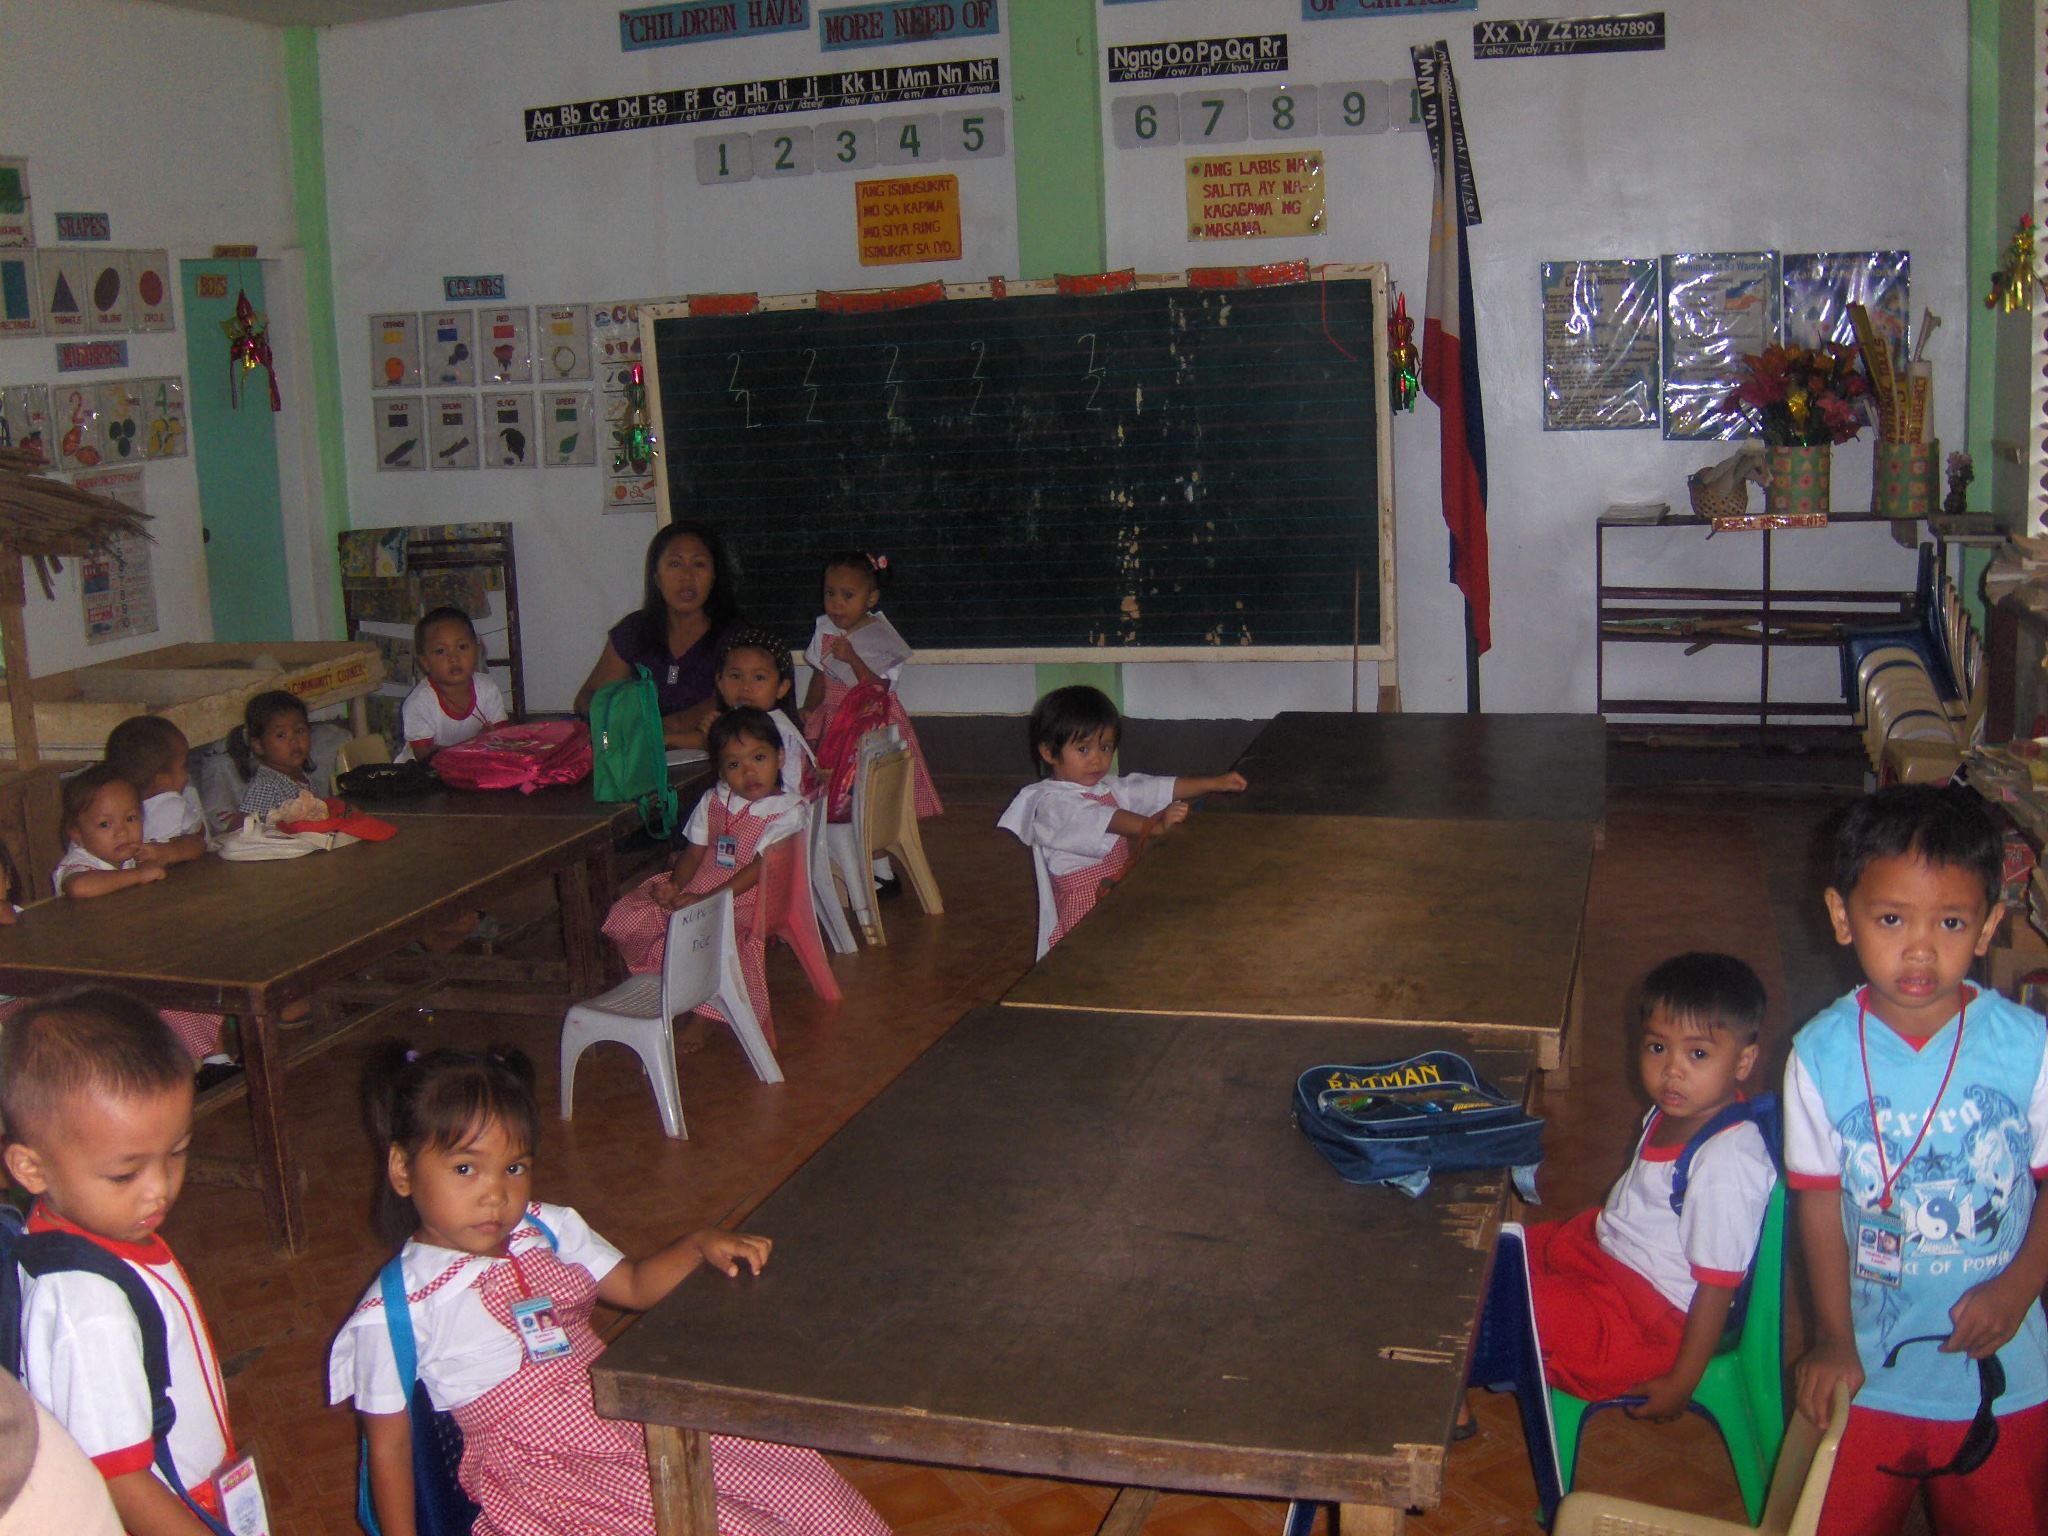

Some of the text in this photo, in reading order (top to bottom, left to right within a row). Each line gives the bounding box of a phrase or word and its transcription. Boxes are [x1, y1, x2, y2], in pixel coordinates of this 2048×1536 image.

[748, 0, 803, 28] HAVE
[825, 0, 992, 43] MORE NEED OF
[1482, 20, 1655, 46] Xx Yy Zz 1234567890
[1114, 37, 1281, 72] Ngng Oo Pp Qq Rr
[532, 109, 553, 129] Aa
[560, 106, 581, 125] Bb
[590, 102, 609, 121] Cc
[618, 96, 640, 118] Dd
[648, 95, 667, 114] Ee
[685, 89, 700, 111] Ff
[713, 87, 736, 111] Gg
[744, 83, 768, 104] Hh
[803, 76, 819, 101] Jj
[841, 72, 865, 94] Kk
[871, 69, 888, 91] Ll
[897, 68, 930, 88] Mm
[937, 64, 961, 84] Nn
[1135, 88, 1425, 139] 6 7 8 9 1
[718, 117, 984, 176] 1 2 3 4 5
[1204, 162, 1232, 177] ANG
[1239, 159, 1281, 175] LABIS
[1202, 183, 1251, 198] SALITA
[1259, 181, 1276, 195] AY
[1204, 201, 1302, 219] KAGAGAWA NG
[448, 279, 503, 297] COLORS
